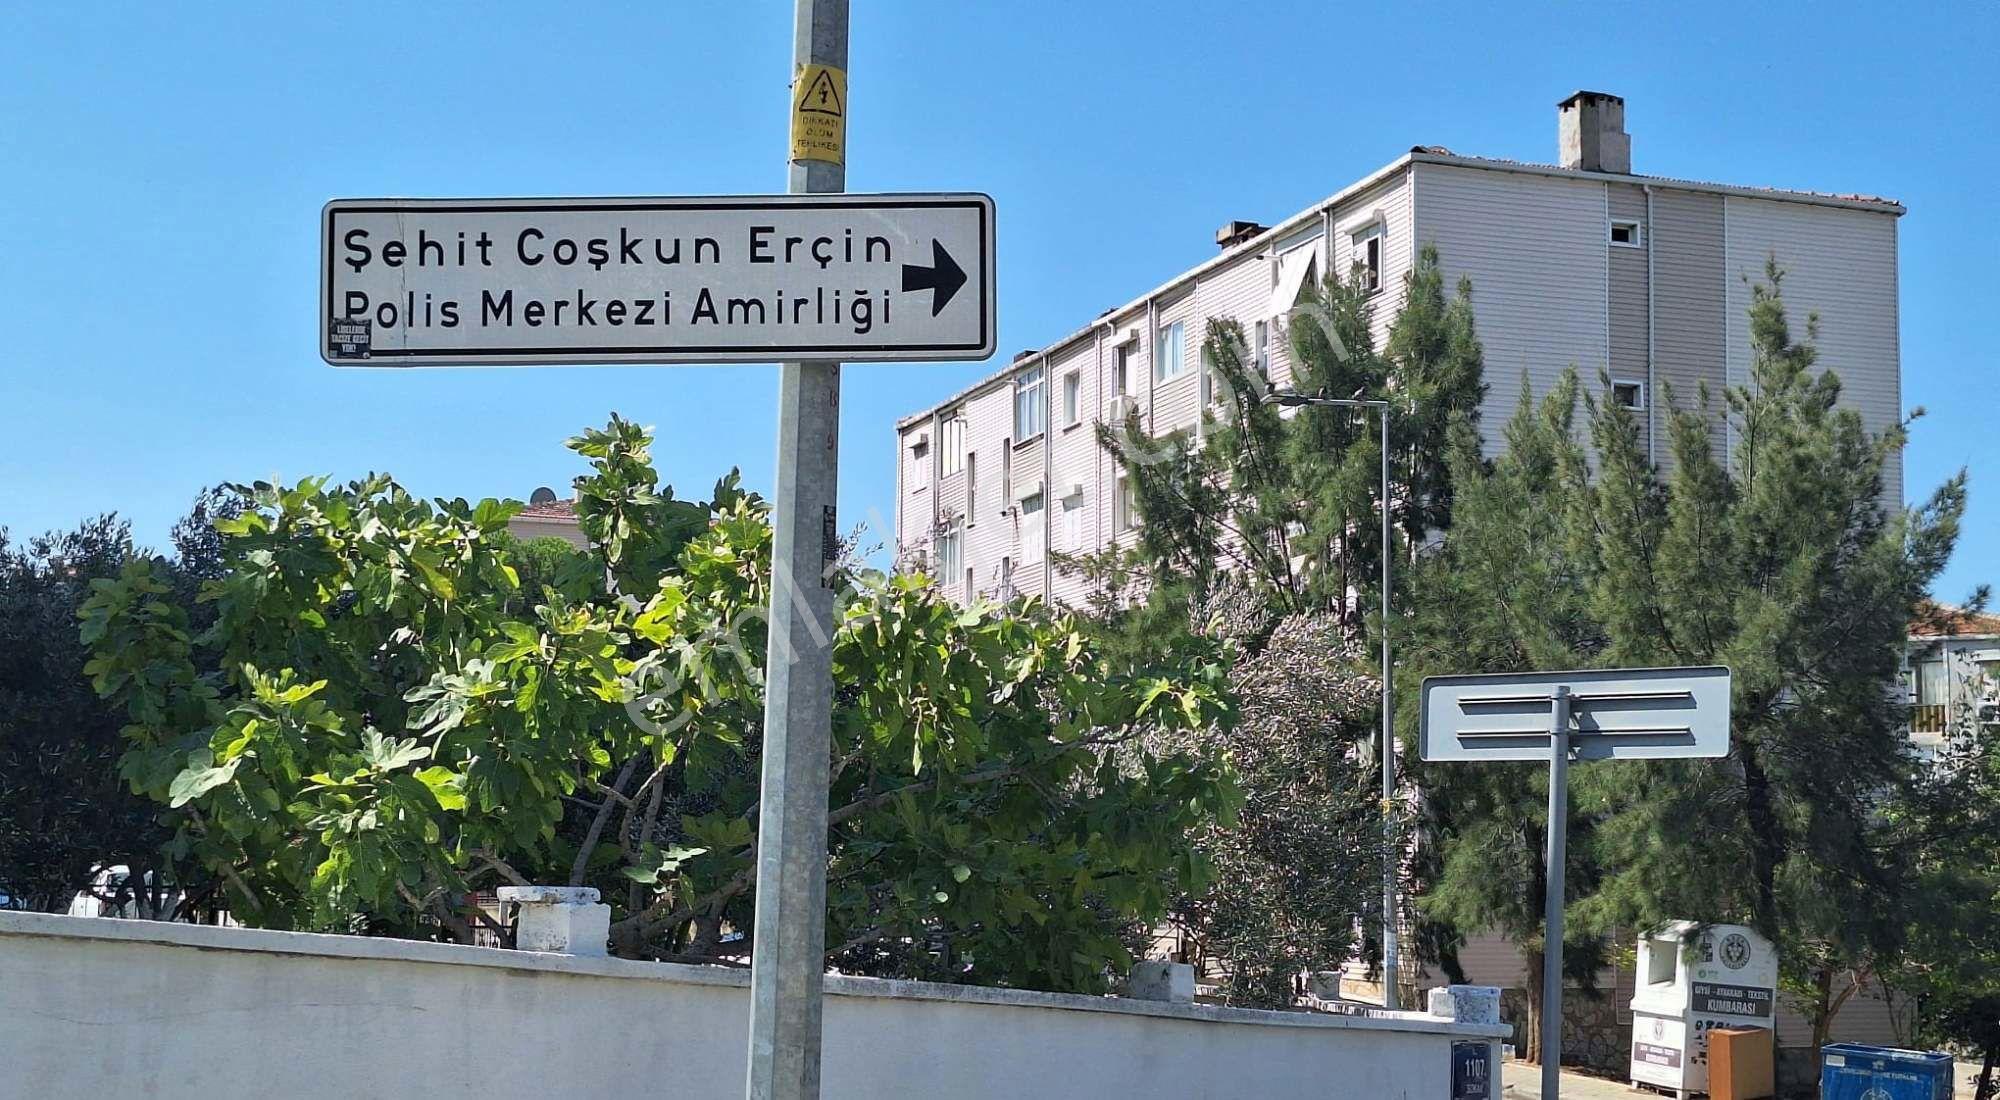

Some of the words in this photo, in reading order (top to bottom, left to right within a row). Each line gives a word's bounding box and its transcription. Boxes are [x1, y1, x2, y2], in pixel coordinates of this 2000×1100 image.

[344, 228, 493, 274] Şehit
[517, 227, 720, 272] Coşkun
[749, 226, 891, 270] Erçin
[345, 290, 460, 329] Polis
[481, 288, 670, 328] Merkezi
[690, 286, 890, 335] Amirliği
